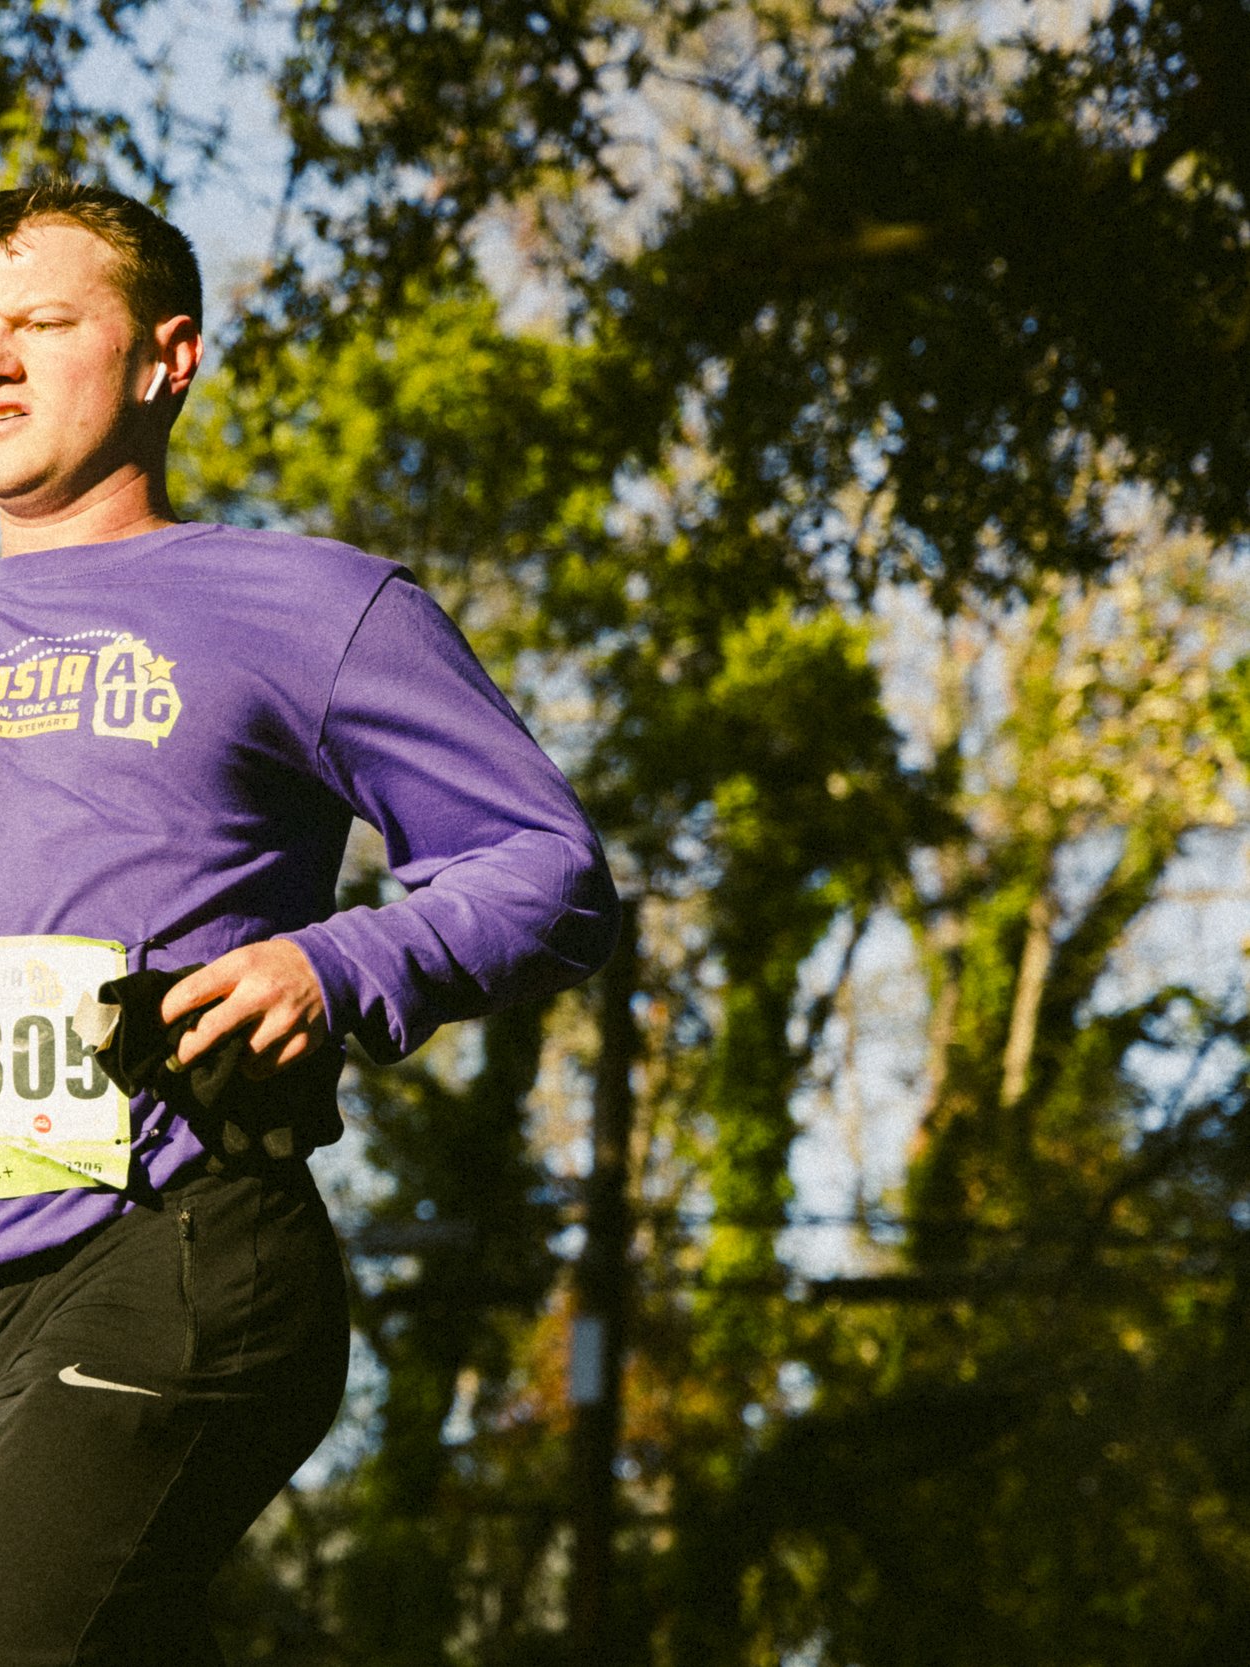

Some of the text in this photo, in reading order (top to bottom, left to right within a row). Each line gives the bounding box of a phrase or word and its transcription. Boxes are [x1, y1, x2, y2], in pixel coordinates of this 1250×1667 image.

[102, 652, 136, 684] A
[16, 703, 45, 717] 10K
[47, 701, 58, 712] &
[60, 698, 80, 711] 5K
[103, 688, 172, 728] UG
[17, 718, 68, 733] STEWART
